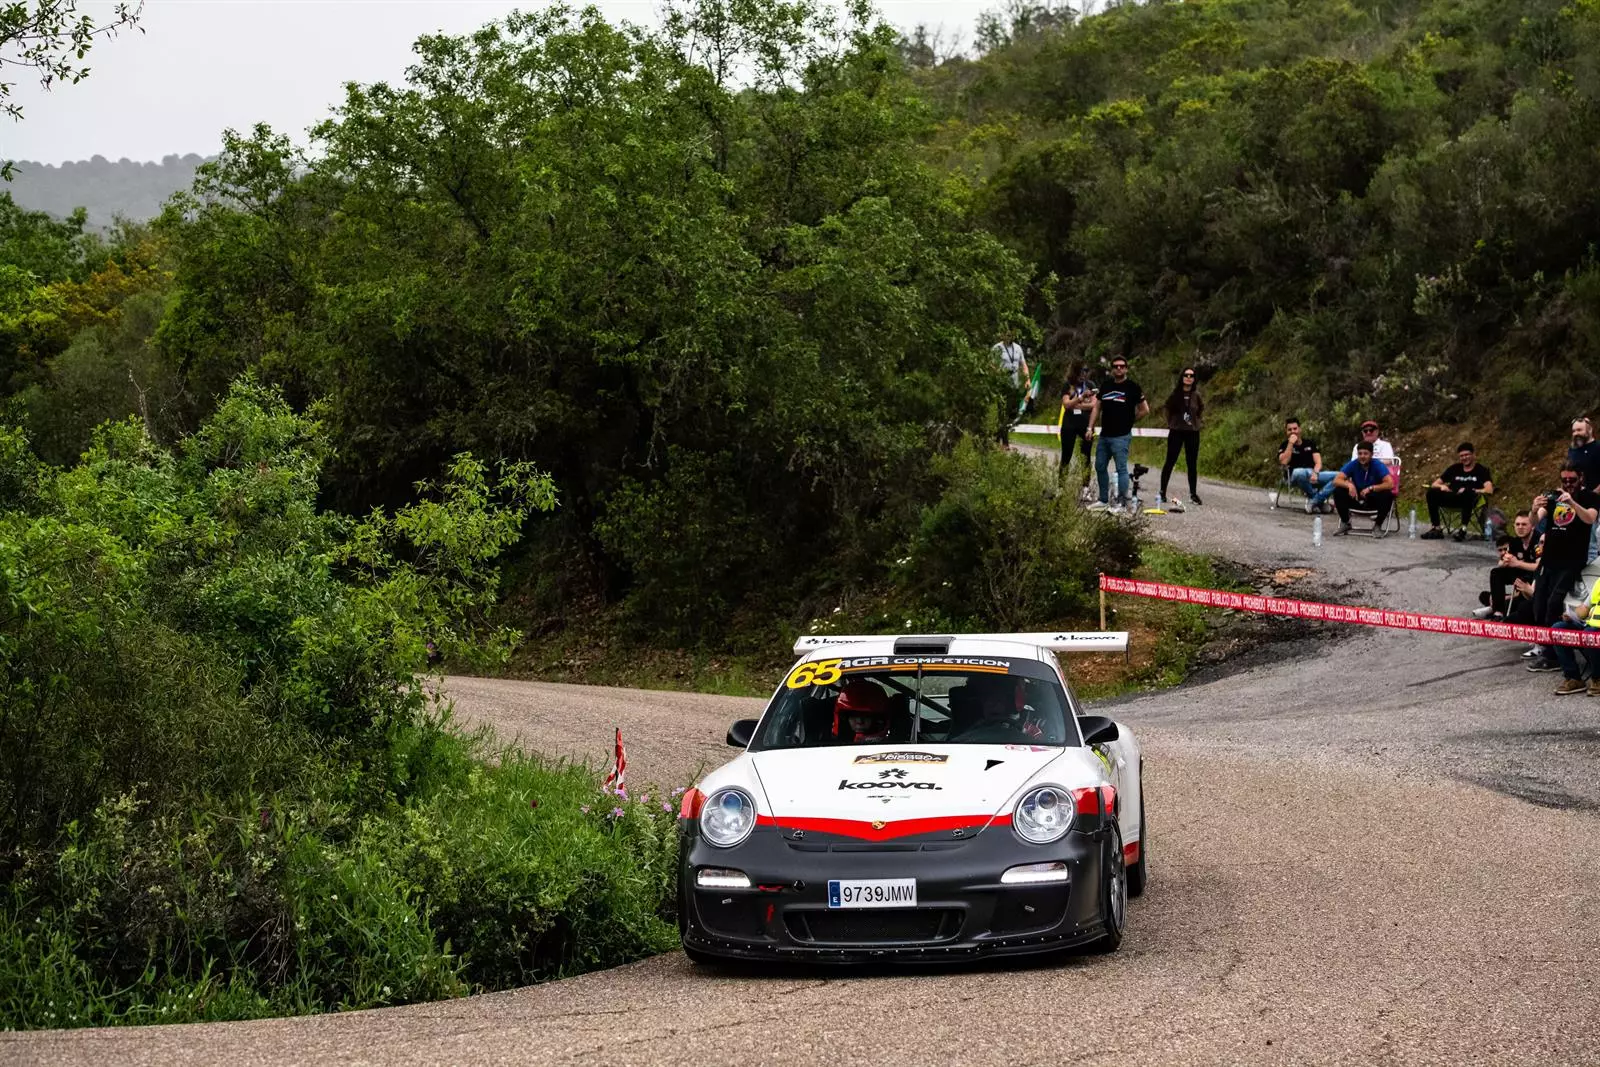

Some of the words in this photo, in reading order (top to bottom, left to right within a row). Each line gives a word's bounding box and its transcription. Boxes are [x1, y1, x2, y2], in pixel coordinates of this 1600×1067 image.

[1212, 592, 1229, 605] PUBLICO
[1231, 595, 1242, 607] ZONA
[1243, 596, 1265, 610] PROHIBIDO
[1268, 599, 1285, 612] PUBLICO
[1287, 601, 1299, 614] ZONA
[1300, 603, 1323, 617] PROHIBIDO
[1325, 606, 1343, 619] PUBLICO
[1346, 608, 1357, 620] ZONA
[1359, 610, 1383, 624] PROHIBIDO
[1385, 613, 1404, 626] PUBLICO
[1407, 615, 1420, 628] ZONA
[1421, 616, 1446, 631] PROHIBIDO
[1448, 620, 1468, 633] PUBLICO
[1470, 622, 1482, 635] ZONA
[1485, 624, 1511, 638] PROHIBIDO
[1514, 626, 1534, 640] PUBLICO
[1536, 629, 1550, 641] ZONA
[1552, 631, 1580, 645] PROHIBIDO
[786, 658, 843, 689] 65
[893, 657, 1010, 667] COMPETICION
[843, 885, 914, 903] 9739JMW
